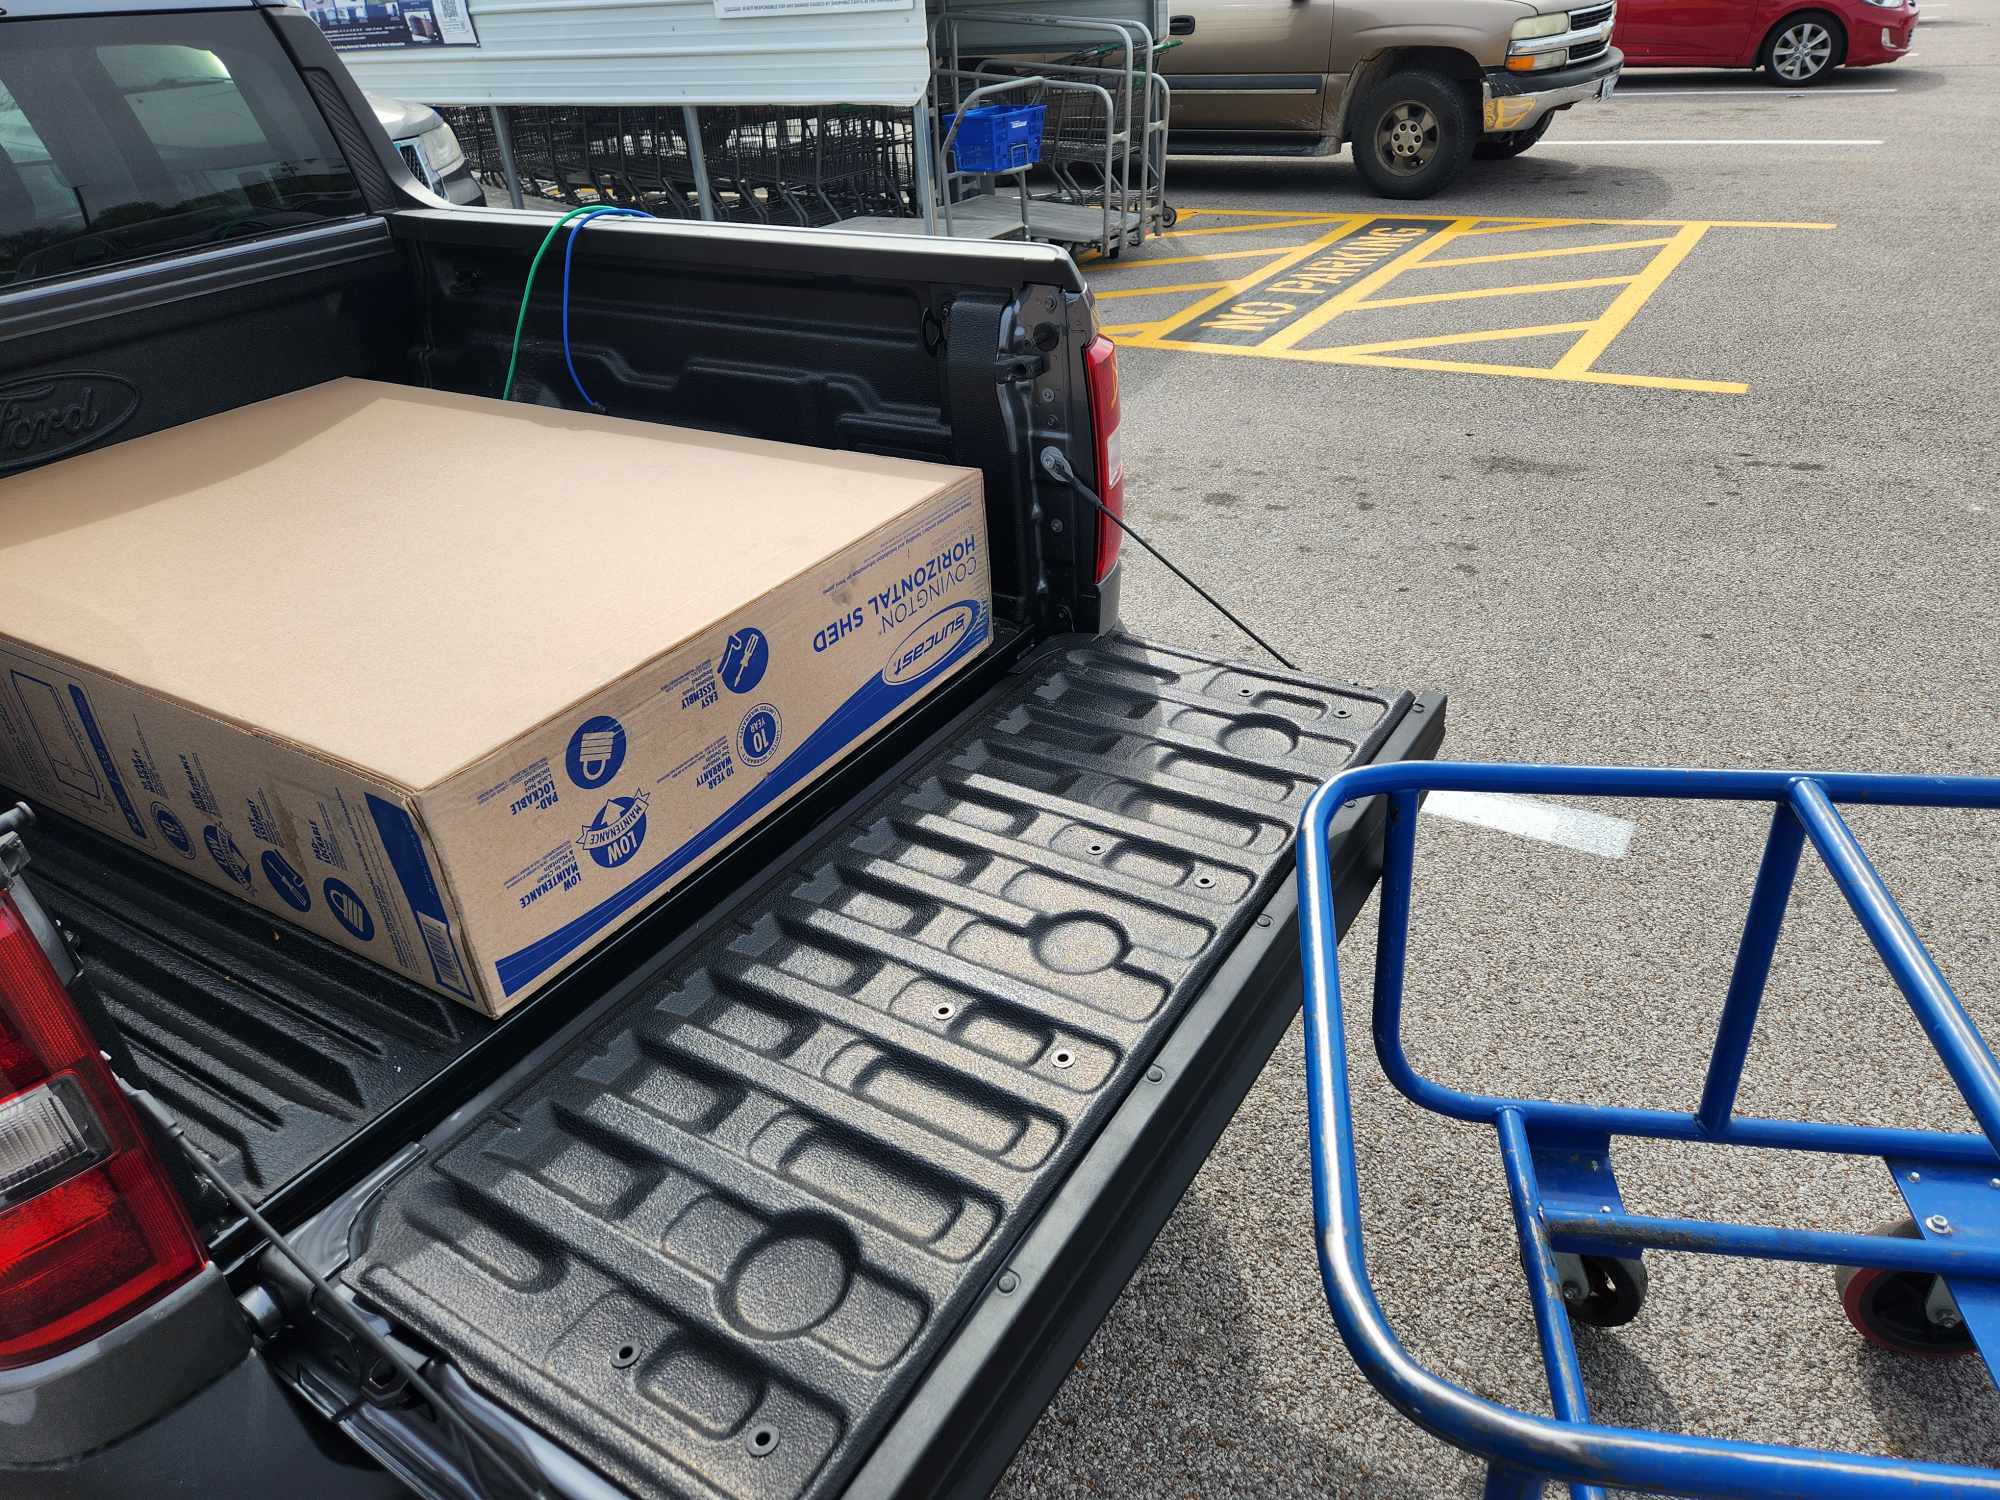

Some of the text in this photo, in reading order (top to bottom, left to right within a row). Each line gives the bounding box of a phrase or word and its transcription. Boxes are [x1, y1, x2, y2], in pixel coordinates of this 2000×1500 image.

[1200, 226, 1429, 332] NO PARKING
[868, 534, 975, 615] HORIZONTAL
[882, 556, 977, 633] COVINGTON
[813, 607, 863, 652] SHED
[894, 613, 965, 675] suncast
[681, 680, 716, 709] ASSEMBLY
[701, 691, 718, 709] EASY
[750, 717, 766, 733] YEAR
[753, 727, 769, 754] 10
[696, 756, 732, 787] WARRANTY
[707, 765, 735, 789] 10 YEAR
[510, 780, 555, 815] LOCKABLE
[536, 791, 559, 810] PAD-
[589, 804, 642, 845] MAINTENANCE
[608, 831, 637, 865] LOW
[519, 861, 578, 909] MAINTENANCE
[563, 872, 581, 891] LOW
